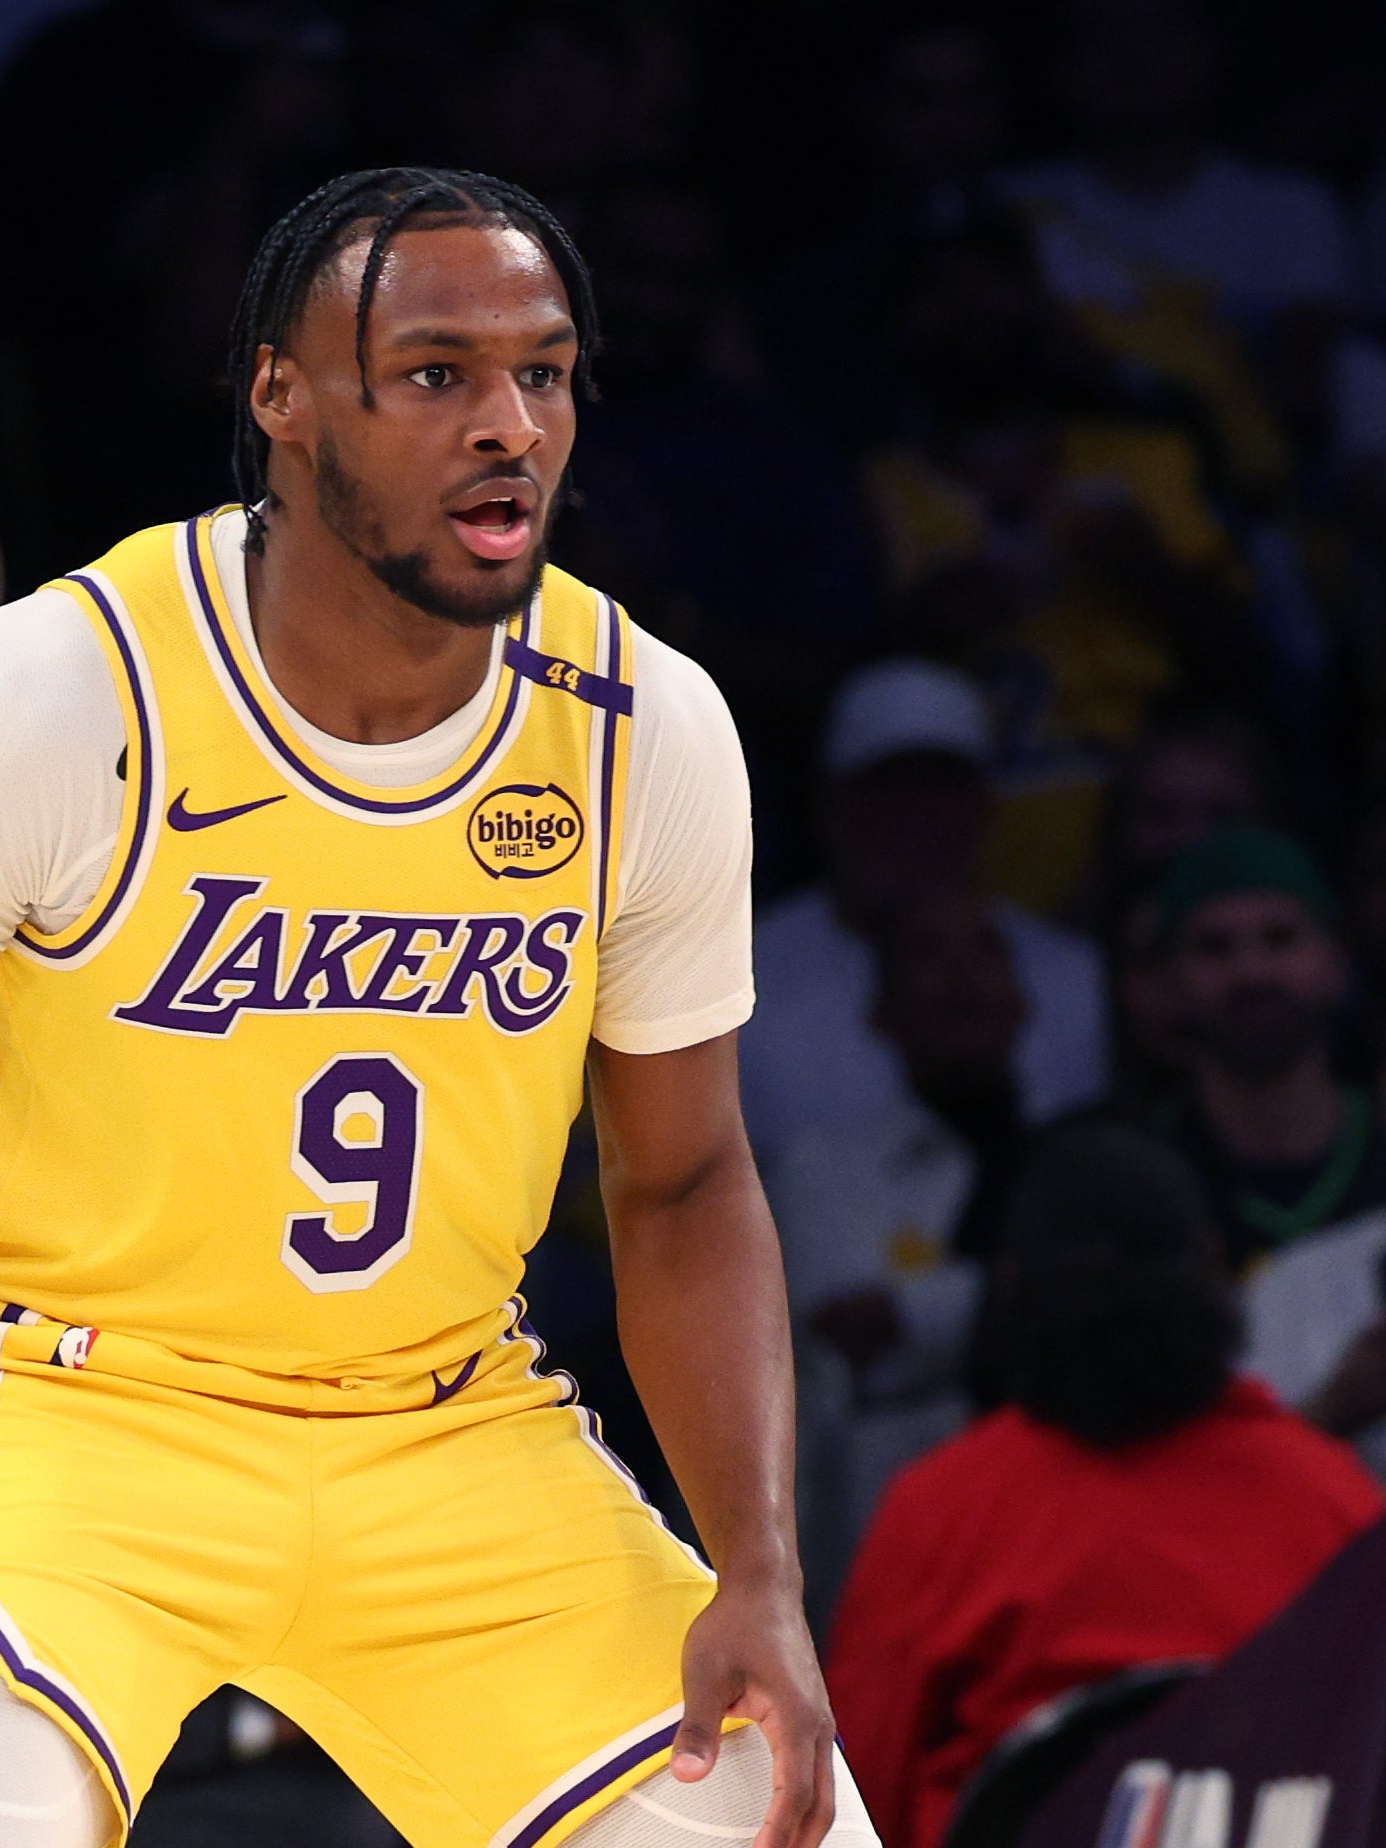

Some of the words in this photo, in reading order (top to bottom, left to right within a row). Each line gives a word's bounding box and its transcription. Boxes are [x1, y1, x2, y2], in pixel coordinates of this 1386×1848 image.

[545, 661, 581, 692] 44
[477, 808, 576, 850] bibigo
[494, 842, 535, 859] 비비고
[107, 872, 587, 1040] LAKERS
[279, 1051, 426, 1294] 9
